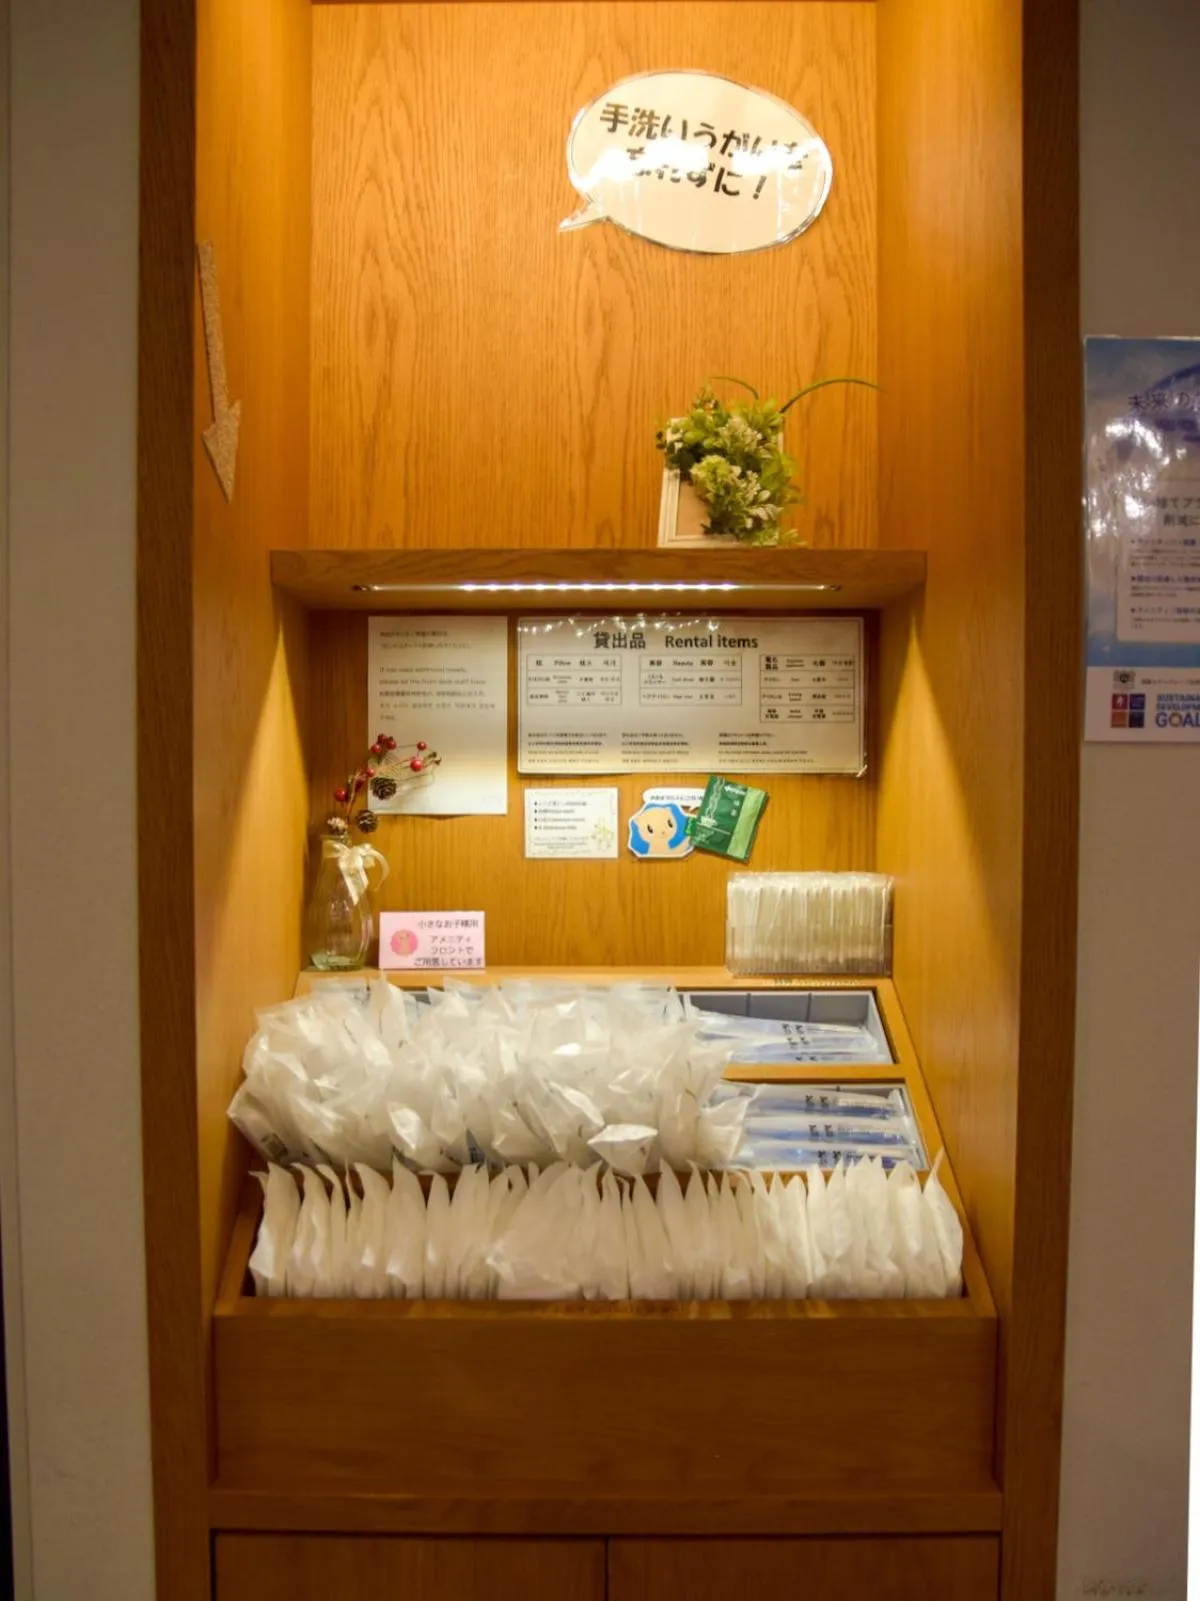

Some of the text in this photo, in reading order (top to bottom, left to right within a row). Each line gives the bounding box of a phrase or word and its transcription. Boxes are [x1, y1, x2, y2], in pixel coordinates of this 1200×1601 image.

[593, 631, 646, 650] 貸出品
[665, 634, 759, 649] Rental items
